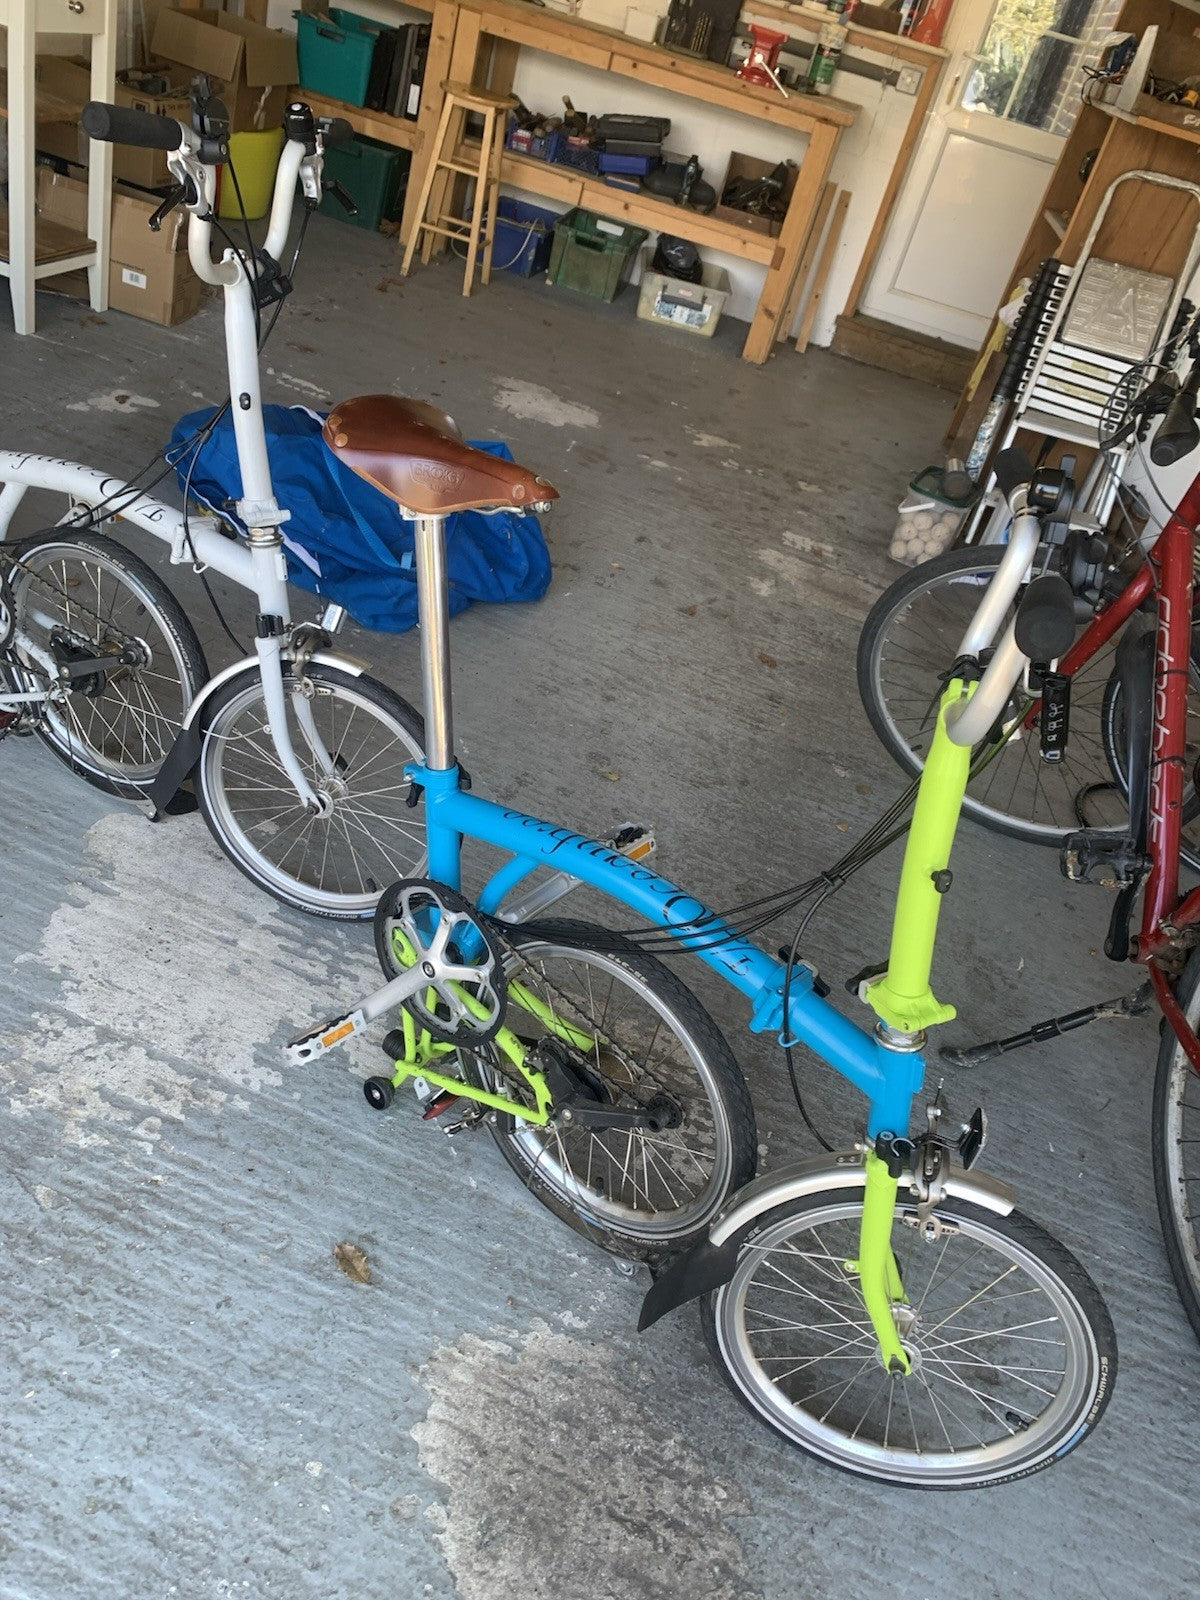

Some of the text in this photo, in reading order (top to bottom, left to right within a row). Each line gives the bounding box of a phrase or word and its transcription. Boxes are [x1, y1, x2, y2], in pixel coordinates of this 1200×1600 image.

[156, 605, 192, 669] MARATHON
[1087, 1356, 1109, 1422] SCHWALBE
[977, 1457, 1054, 1488] MARATHON
